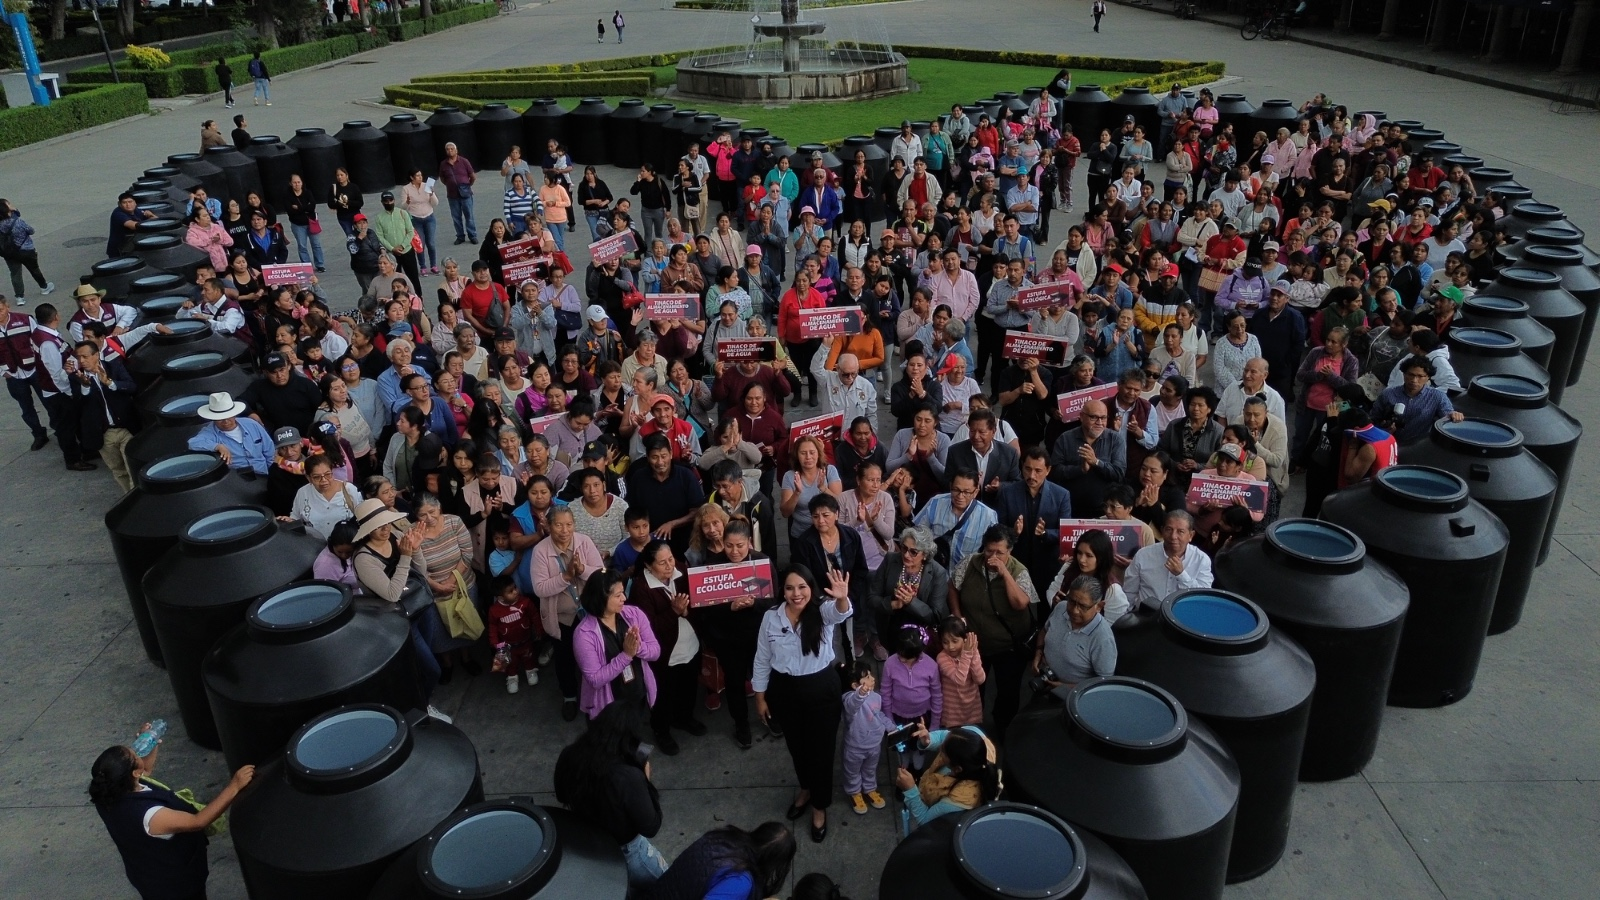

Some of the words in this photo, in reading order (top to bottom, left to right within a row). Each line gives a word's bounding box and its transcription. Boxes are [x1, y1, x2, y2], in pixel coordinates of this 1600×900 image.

[1026, 290, 1046, 298] ESTUFA
[802, 318, 850, 327] ALMACENAMIENTO
[1006, 342, 1054, 352] ALMACENAMIENTO
[1070, 395, 1092, 406] ESTUFA
[800, 424, 820, 435] ESTUFA
[1202, 482, 1231, 490] TINACO
[1192, 486, 1252, 497] ALMACENAMIENTO
[703, 574, 734, 584] ESTUFA
[696, 580, 743, 594] ECOLÓGICA
